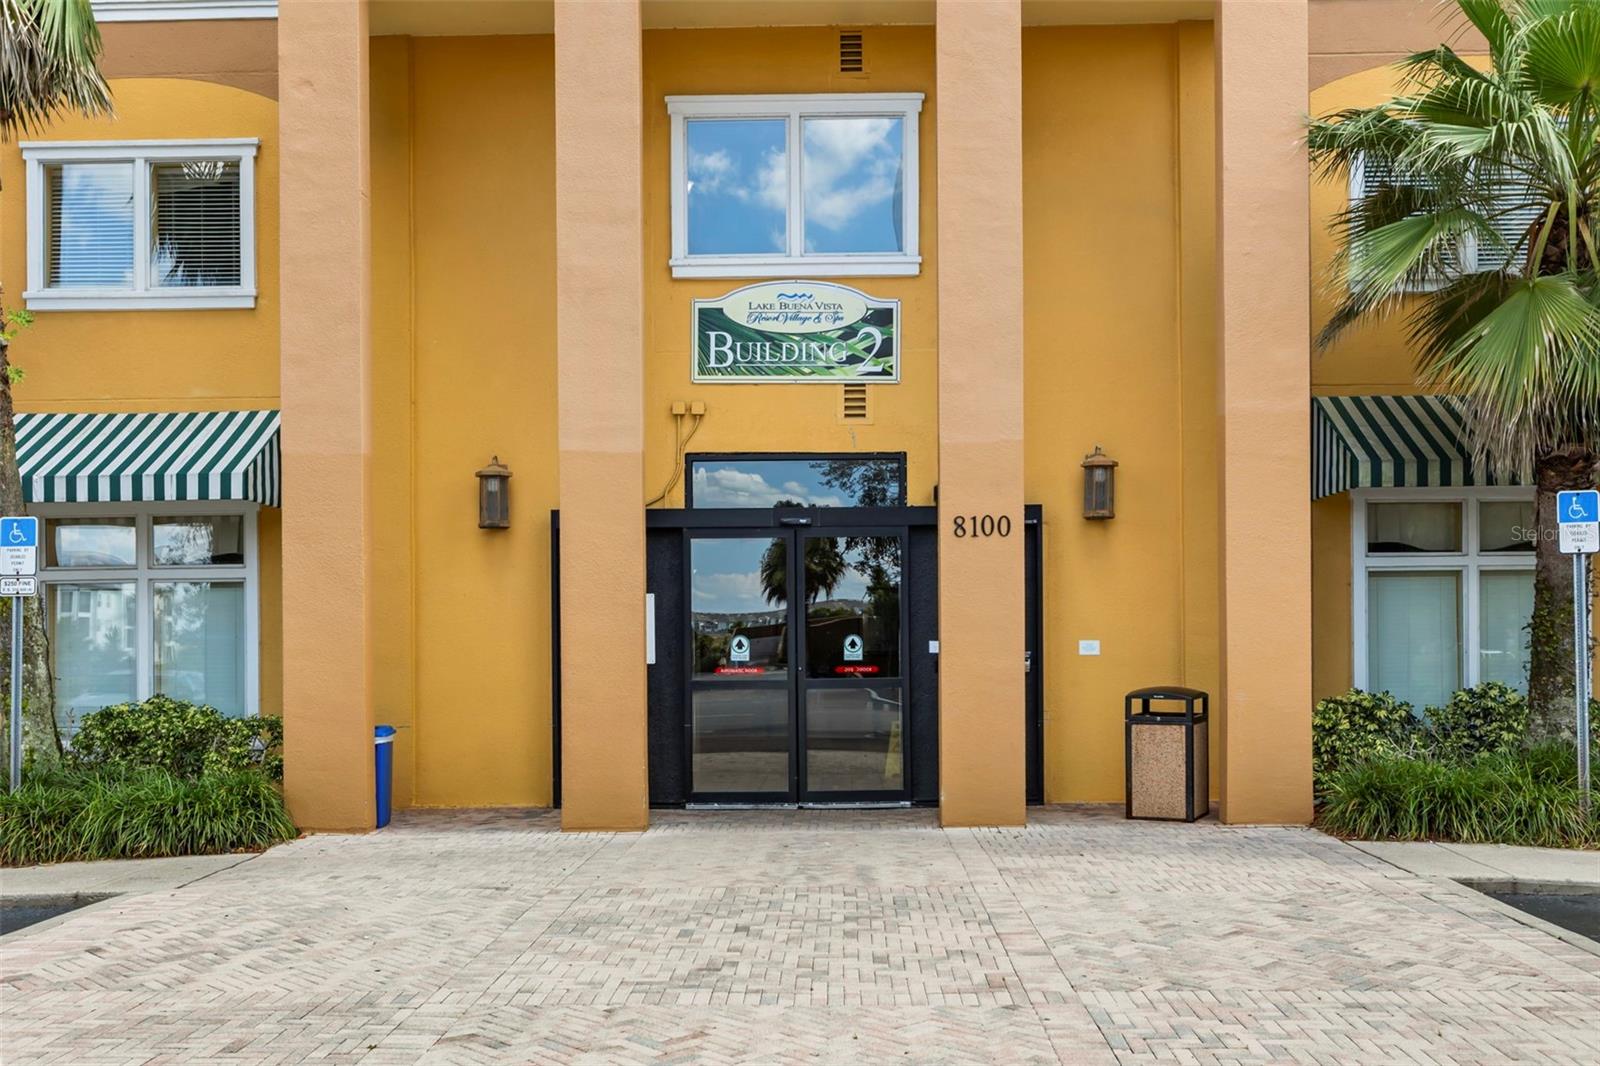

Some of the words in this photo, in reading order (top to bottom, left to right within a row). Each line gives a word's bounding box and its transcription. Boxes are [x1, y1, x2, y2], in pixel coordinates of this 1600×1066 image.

[748, 302, 775, 310] LAKE
[779, 302, 813, 310] BUENA
[815, 302, 843, 310] VISTA
[747, 311, 780, 324] Resort
[780, 311, 812, 325] Village
[813, 312, 821, 323] &
[825, 311, 844, 324] Spa
[706, 331, 848, 368] BUILDING
[856, 326, 884, 373] 2
[953, 515, 1011, 538] 8100
